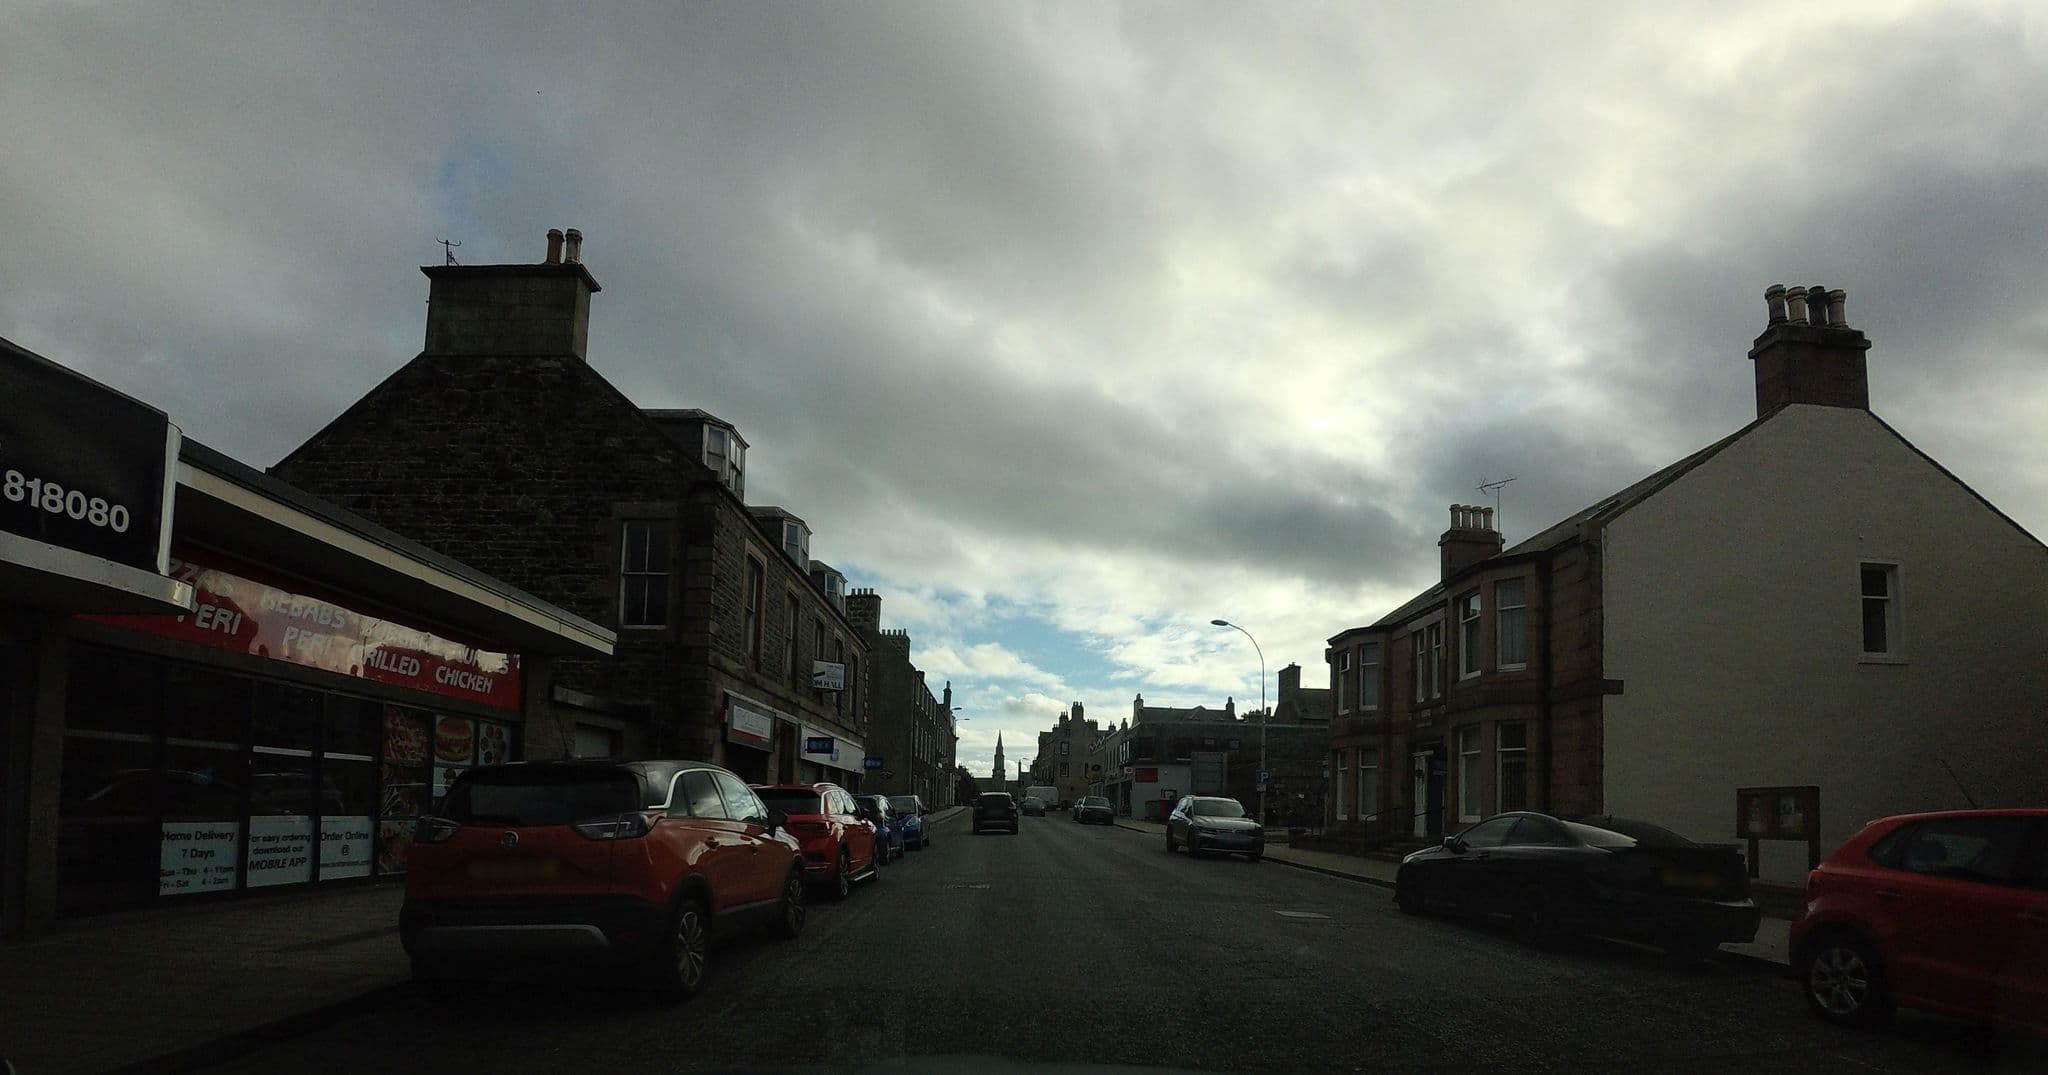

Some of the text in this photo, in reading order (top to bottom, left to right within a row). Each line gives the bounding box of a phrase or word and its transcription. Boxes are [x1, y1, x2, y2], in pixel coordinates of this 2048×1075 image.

[3, 469, 130, 533] 818080
[435, 665, 493, 694] CHICKEN
[195, 830, 235, 842] Delivery
[345, 831, 369, 841] Online
[190, 848, 215, 860] Days
[253, 845, 291, 855] download
[249, 858, 287, 871] MOBILE
[288, 856, 308, 868] APP
